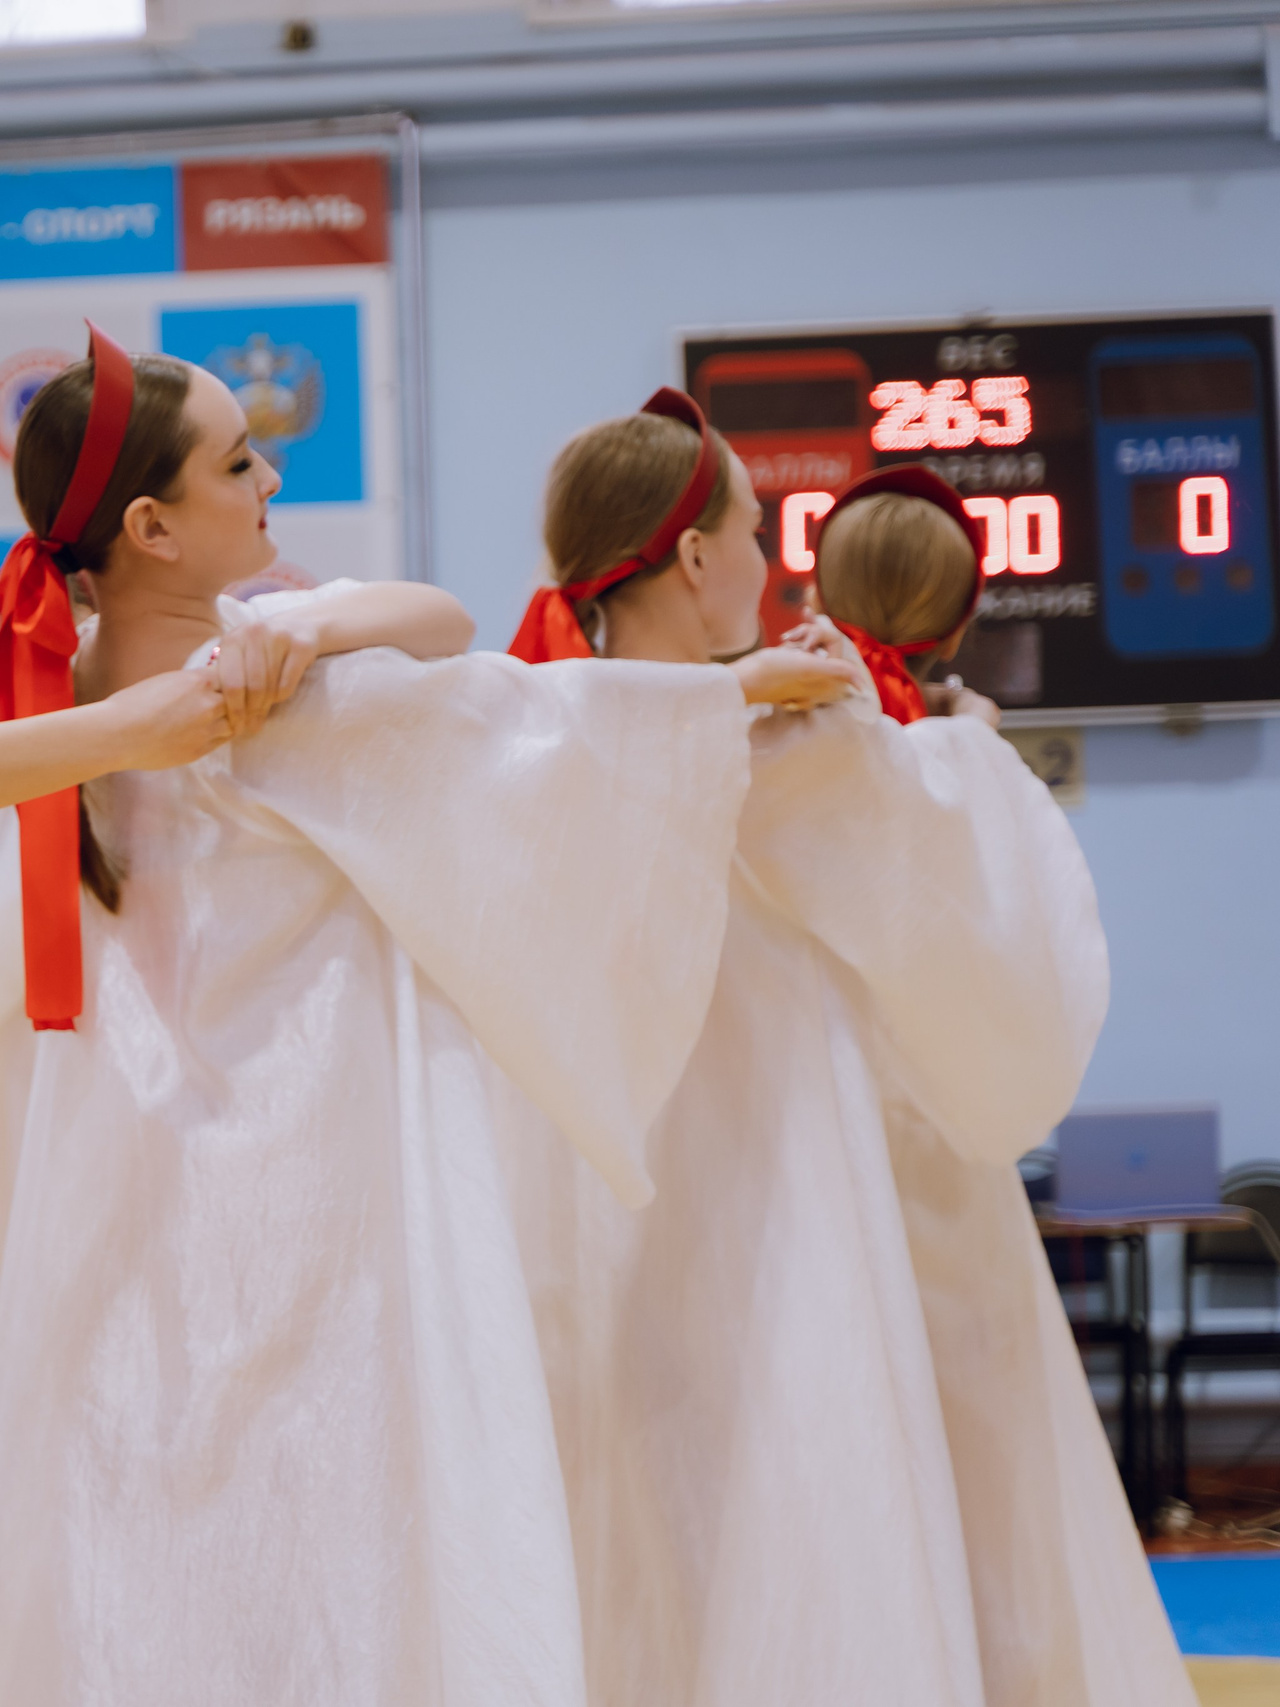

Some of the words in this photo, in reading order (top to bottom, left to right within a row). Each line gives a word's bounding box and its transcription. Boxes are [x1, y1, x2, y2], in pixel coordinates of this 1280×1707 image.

[23, 203, 160, 245] СПОРТ
[204, 194, 368, 237] РЯЗАНЬ
[869, 376, 1032, 451] 265
[742, 452, 852, 489] АЛЛЫ
[1116, 435, 1240, 474] БАЛЛЫ
[1178, 476, 1230, 556] 0
